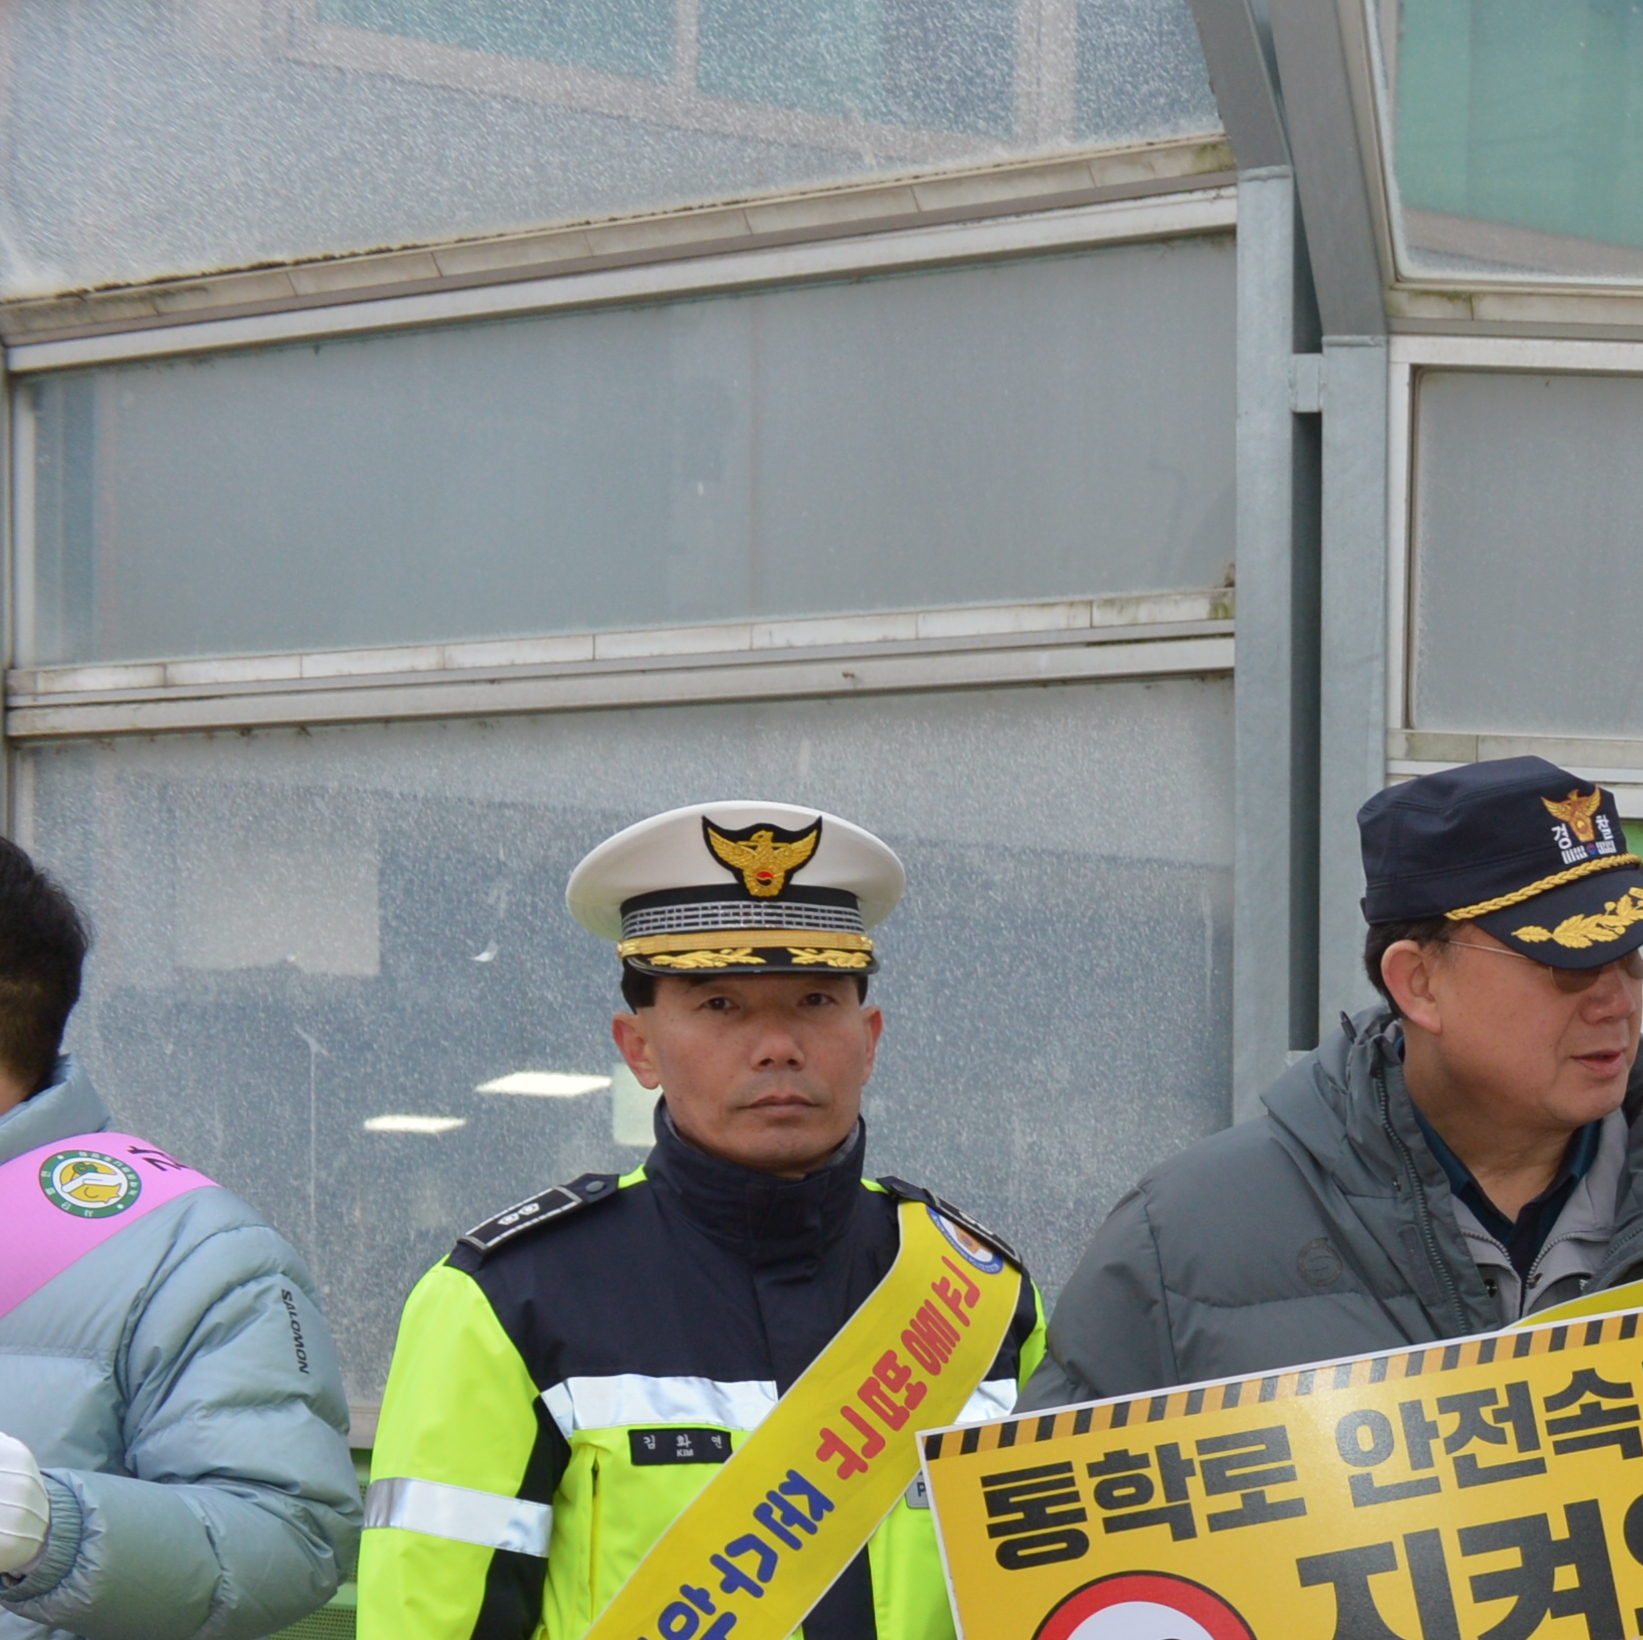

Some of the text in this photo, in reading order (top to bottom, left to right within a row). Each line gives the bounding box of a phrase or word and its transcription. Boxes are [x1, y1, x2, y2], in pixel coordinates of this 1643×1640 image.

[281, 1288, 310, 1375] SALOMON
[816, 1255, 982, 1481] 교통법규
[979, 1425, 1305, 1572] 통학로
